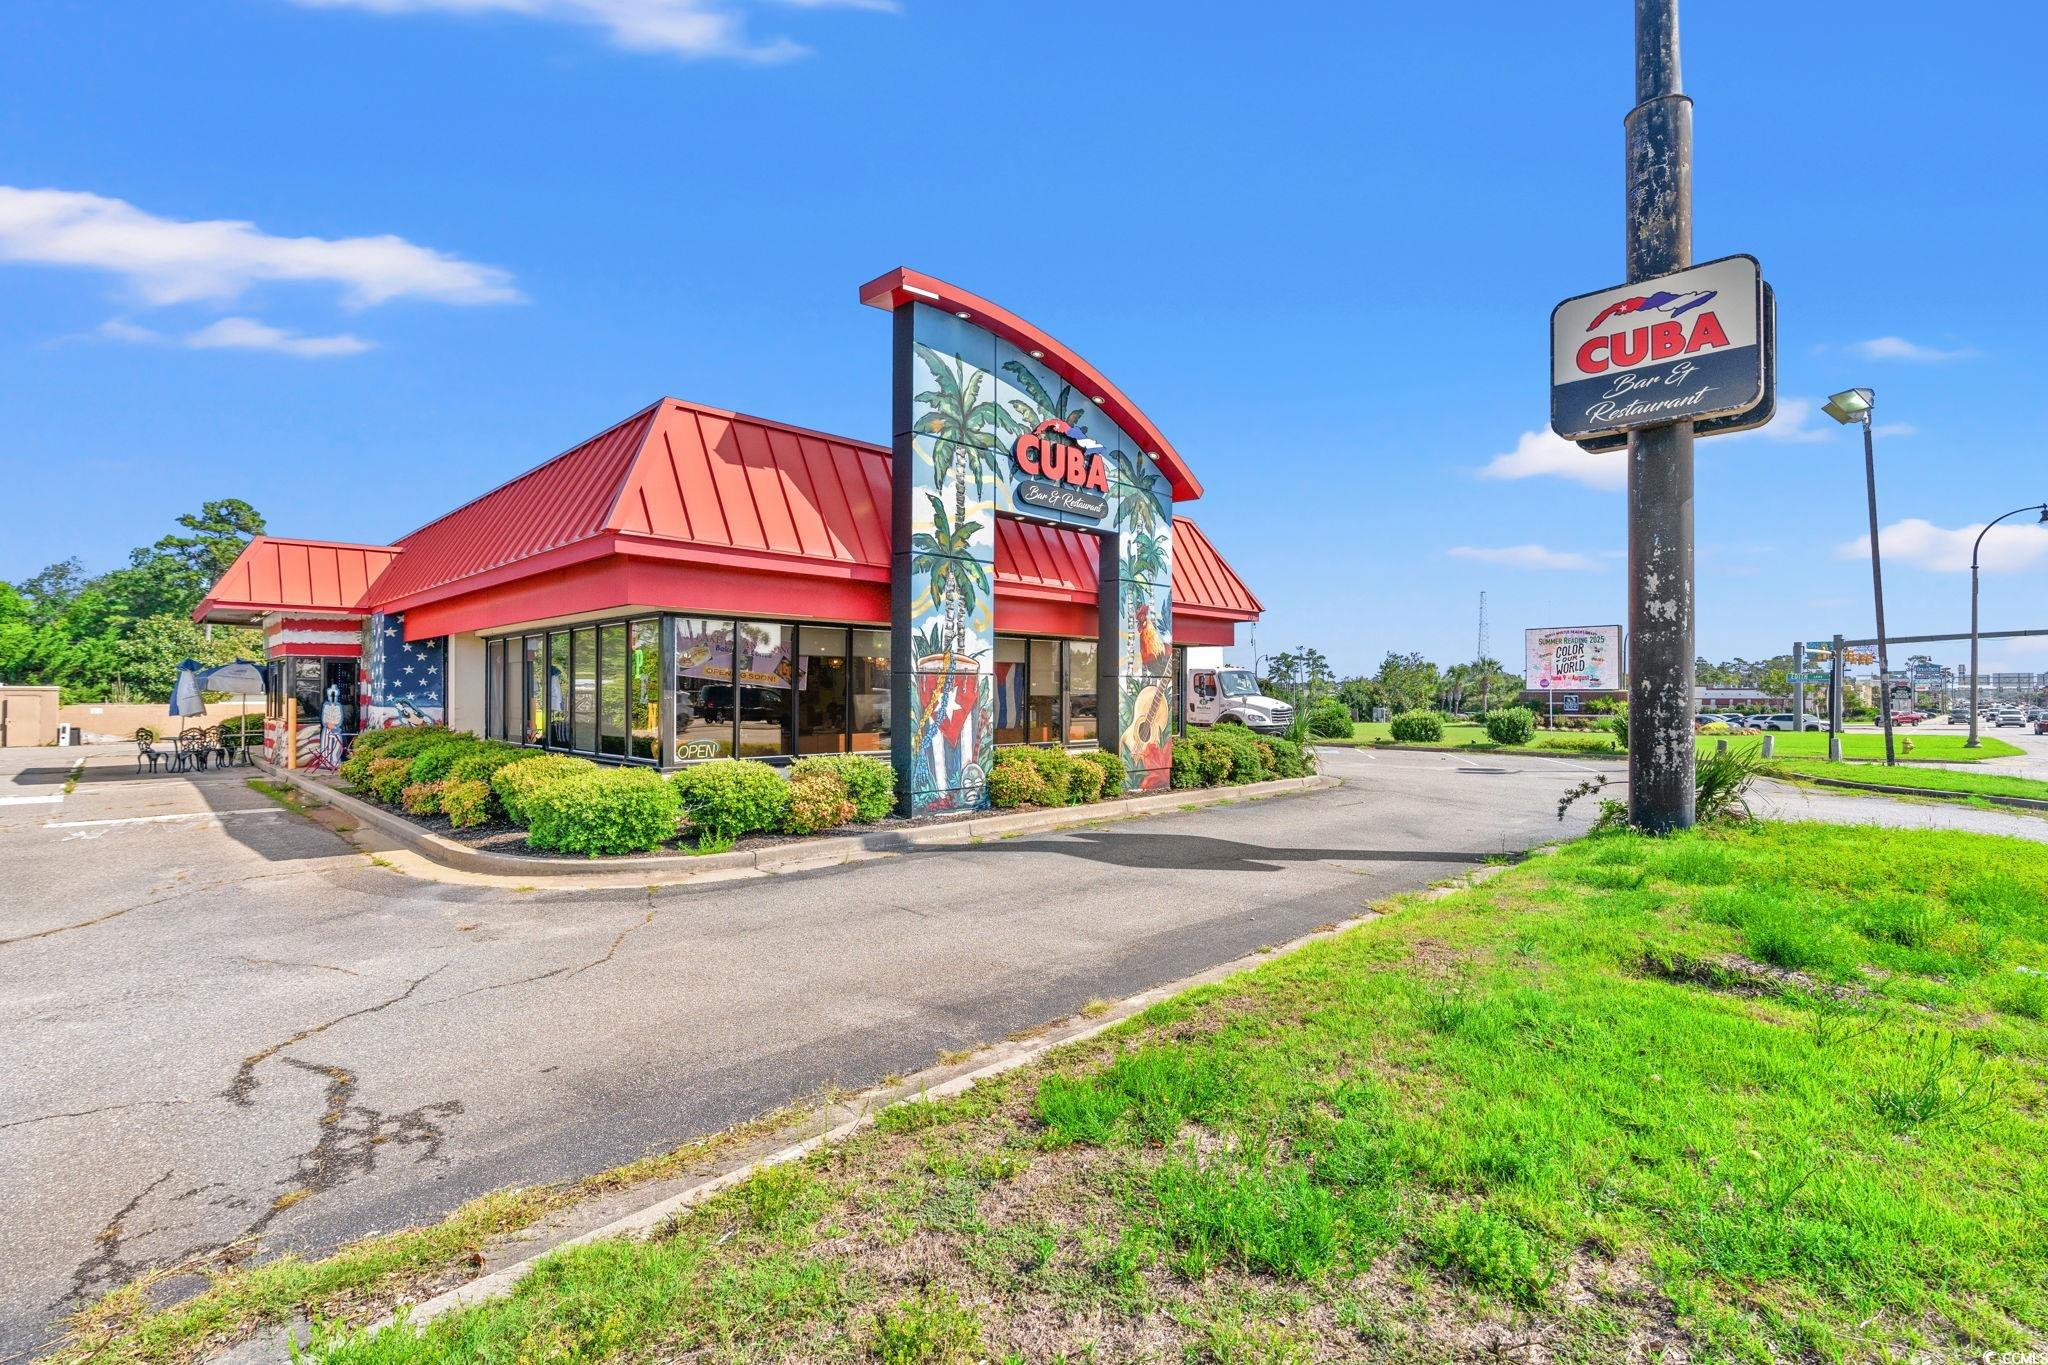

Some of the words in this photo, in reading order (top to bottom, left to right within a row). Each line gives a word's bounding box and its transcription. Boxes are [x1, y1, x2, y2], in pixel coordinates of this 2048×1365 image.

[1575, 311, 1730, 374] CUBA
[1603, 373, 1661, 399] Bar
[1665, 361, 1700, 387] &
[1585, 386, 1721, 424] Restaurant
[1015, 433, 1109, 494] CUBA
[1025, 485, 1048, 501] Bar
[1048, 491, 1061, 507] &
[1061, 493, 1105, 514] Restaurant
[1563, 636, 1587, 644] READING
[1589, 635, 1605, 644] 2025
[1556, 644, 1584, 658] COLOR
[1555, 660, 1585, 675] WORLD
[749, 673, 776, 682] SOON!
[1571, 674, 1590, 682] August
[677, 744, 716, 759] OPEN
